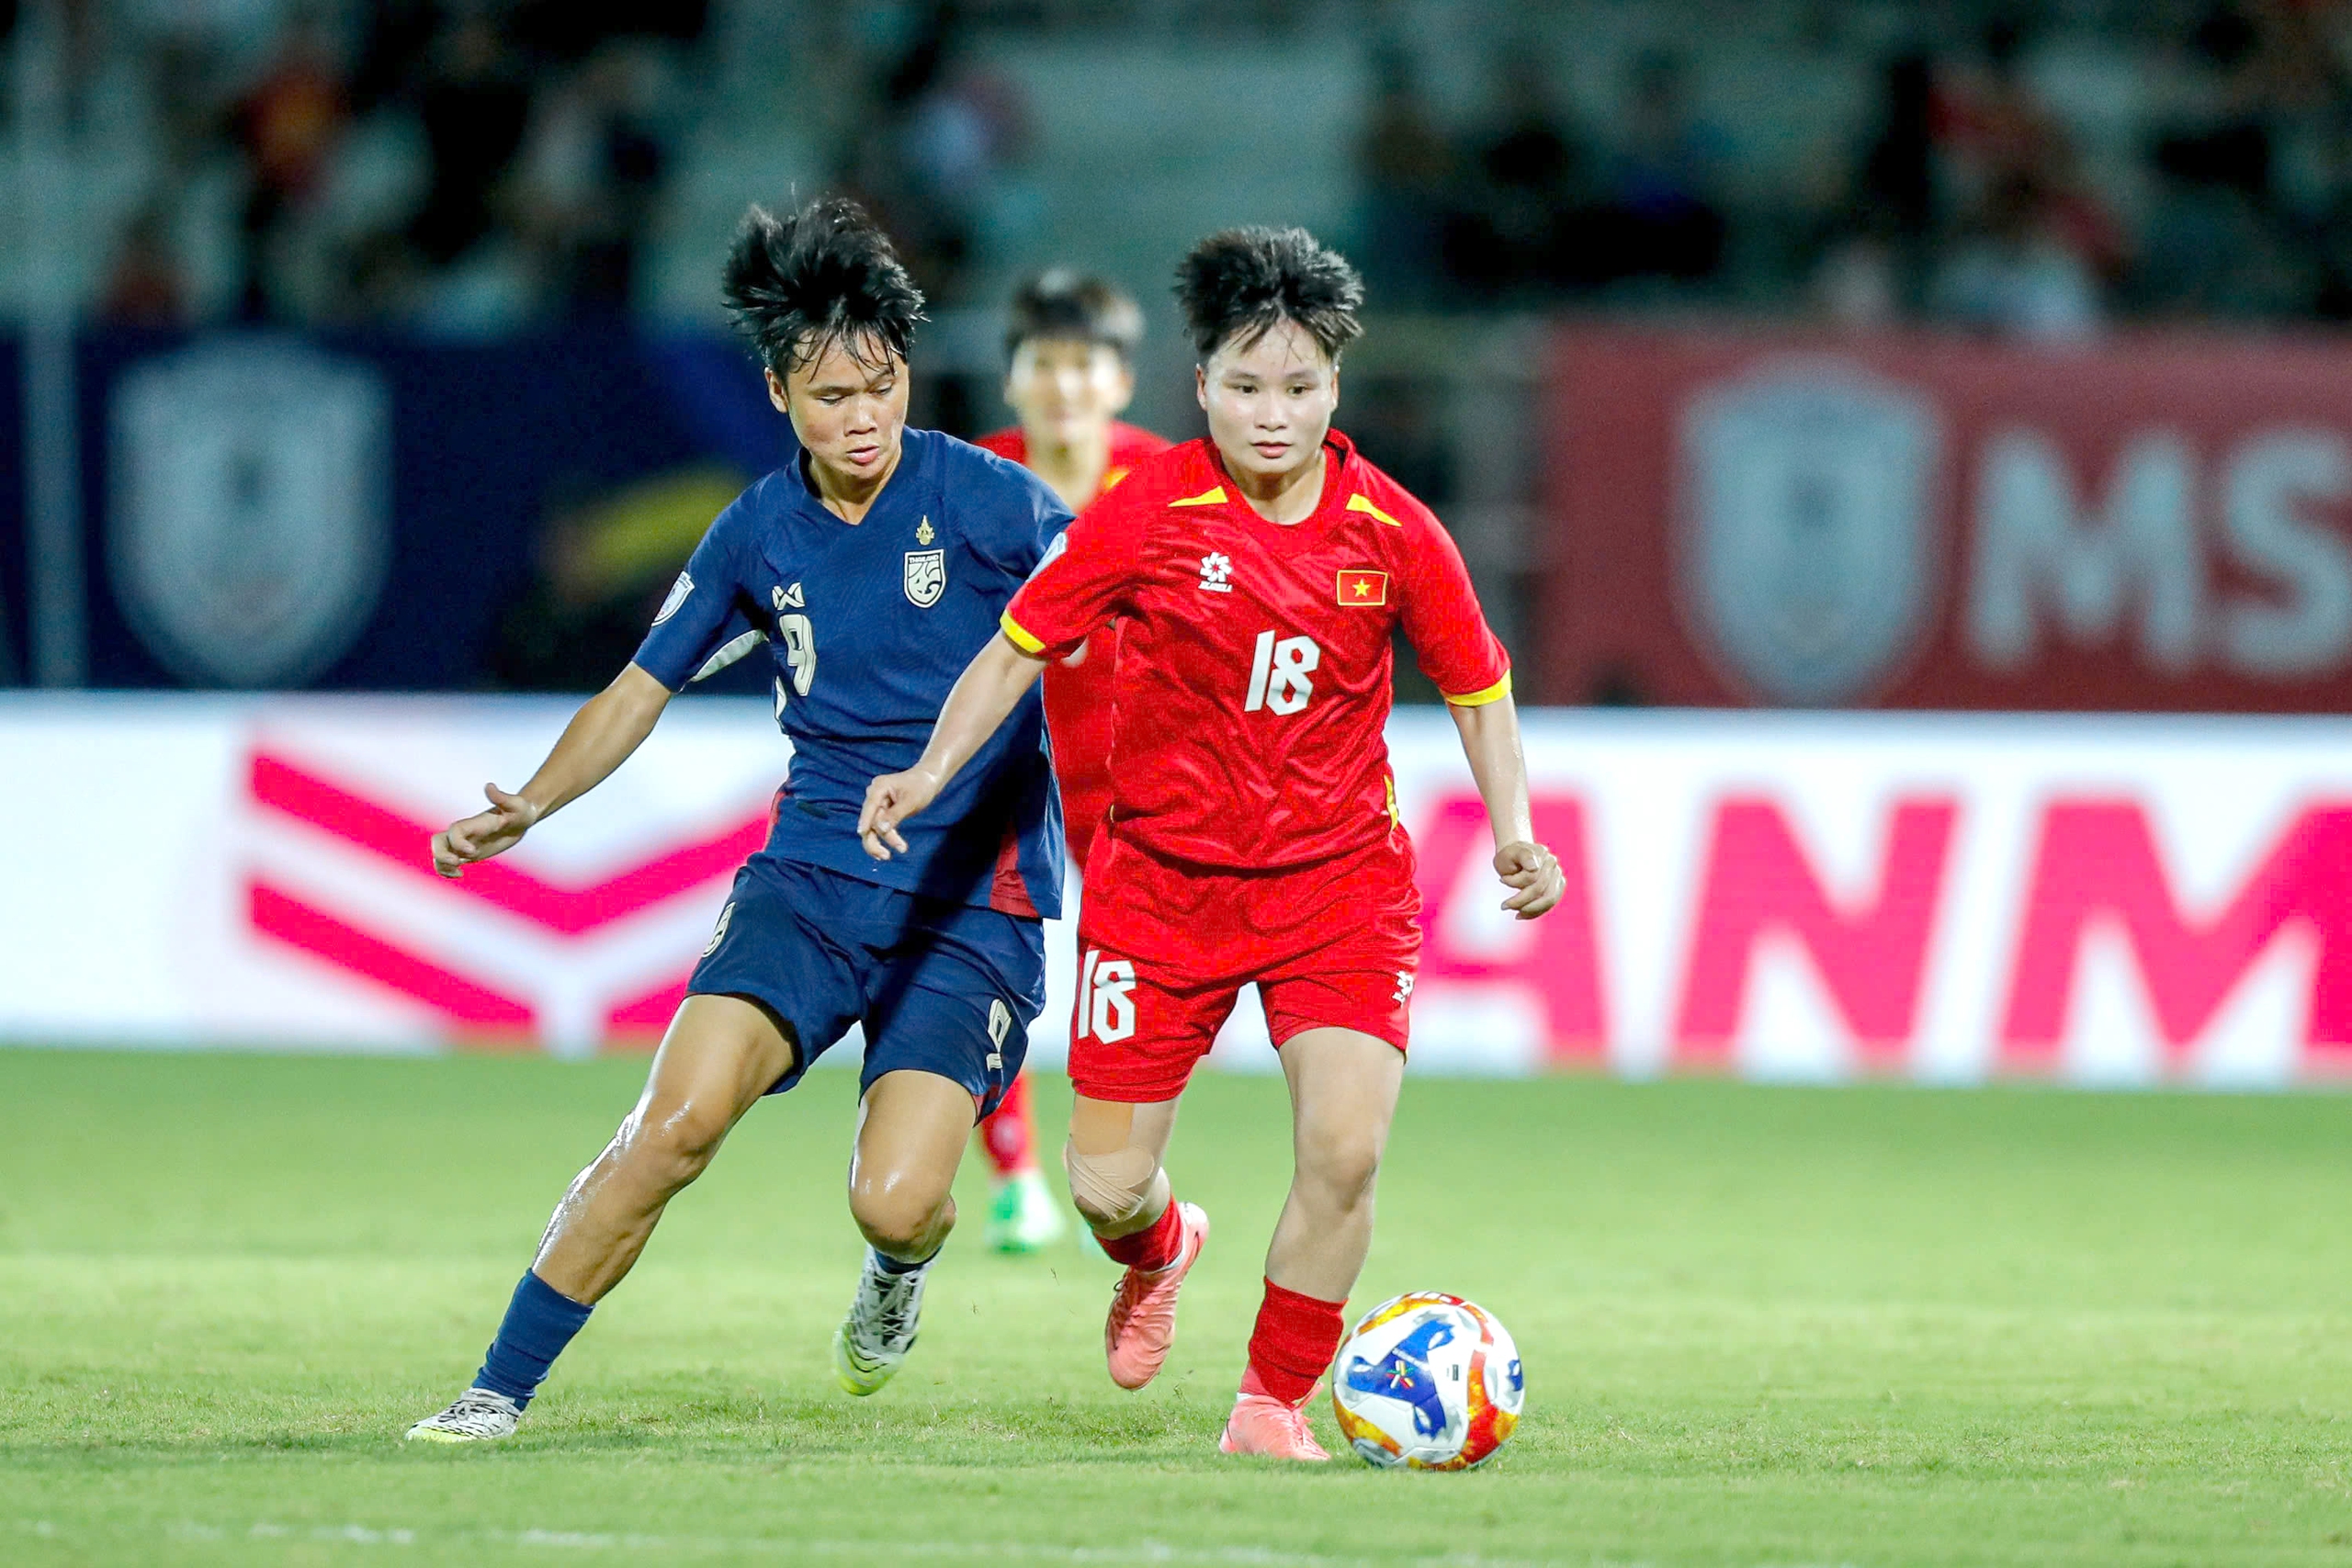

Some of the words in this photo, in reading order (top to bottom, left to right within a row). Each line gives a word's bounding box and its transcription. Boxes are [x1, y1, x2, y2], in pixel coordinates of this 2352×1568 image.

[779, 614, 817, 696] 9
[1244, 629, 1320, 716] 18
[1078, 949, 1136, 1045] 18
